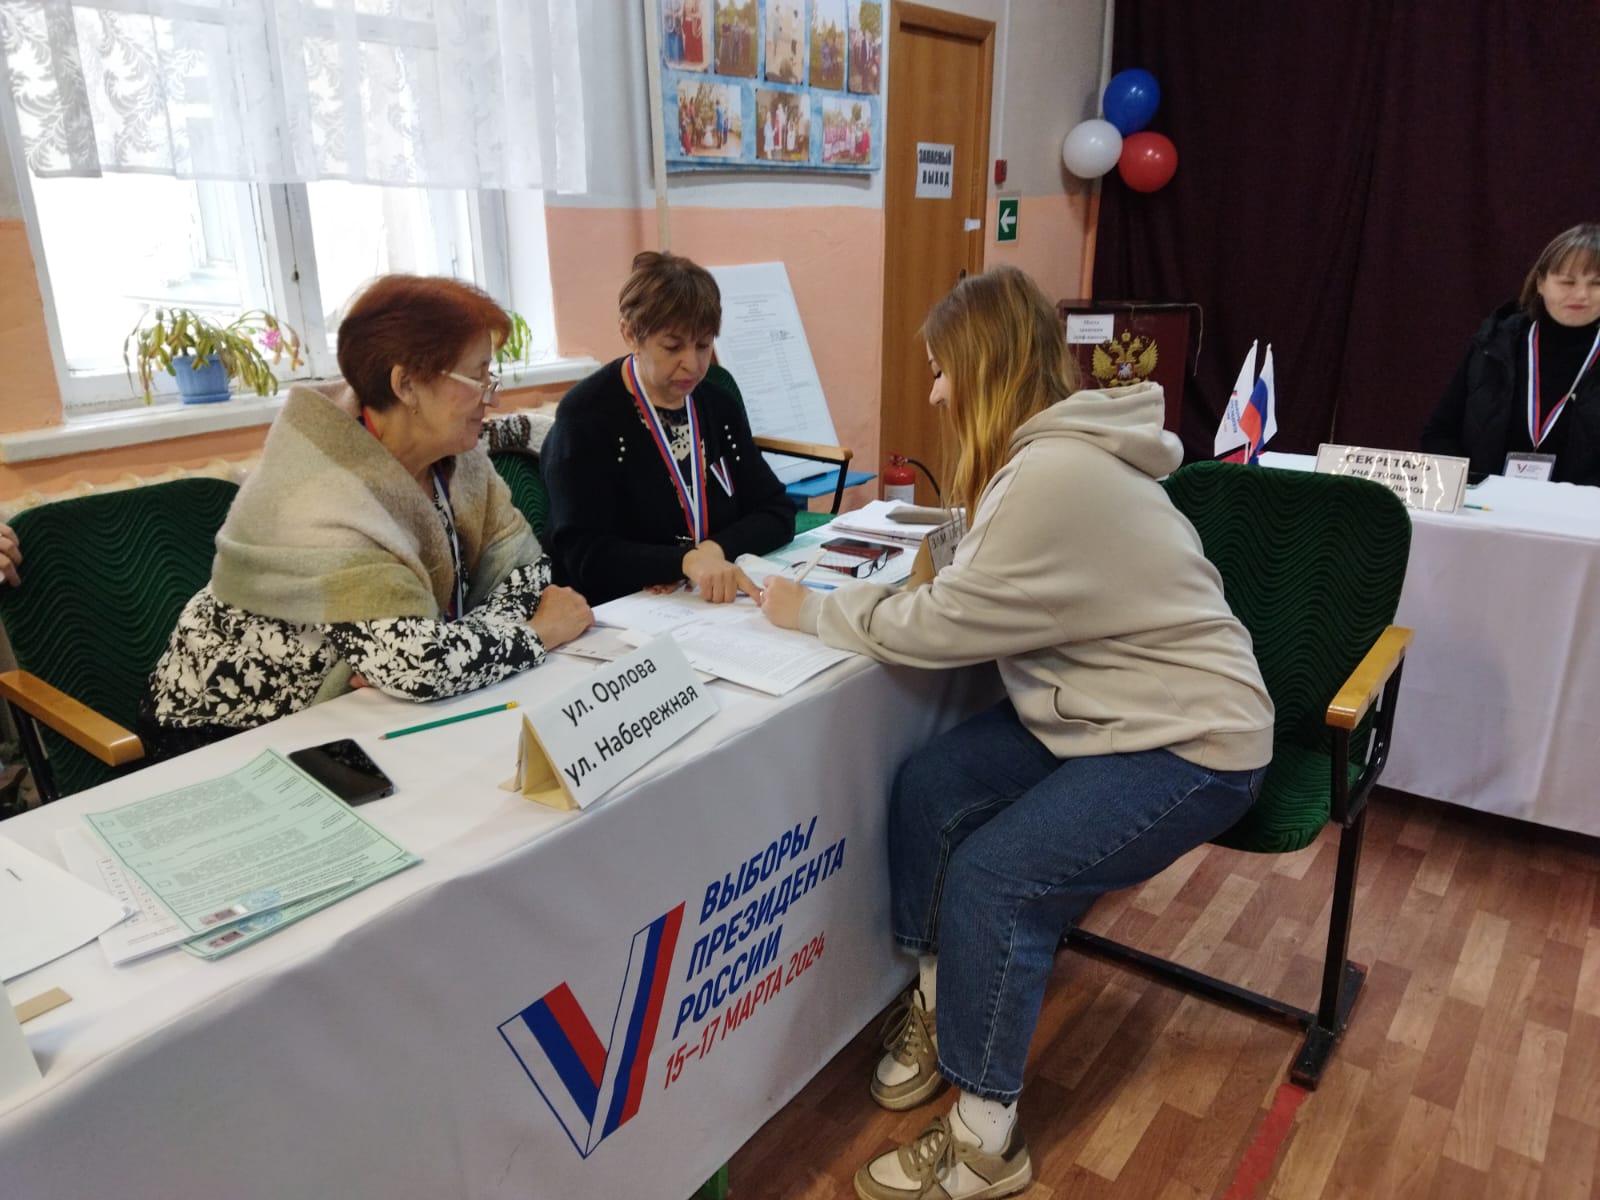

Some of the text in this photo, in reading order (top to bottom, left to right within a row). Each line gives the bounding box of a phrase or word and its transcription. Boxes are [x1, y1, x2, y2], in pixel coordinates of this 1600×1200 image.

[922, 170, 949, 188] ВЫХОД
[561, 657, 657, 727] ул. Орлова
[564, 684, 699, 787] ул. Набережная
[686, 837, 846, 983] ПРЕЗИДЕНТА
[699, 815, 818, 926] ВЫБОРЫ
[672, 924, 783, 1041] РОССИИ
[721, 964, 783, 1041] МАРТА
[784, 930, 825, 987] 2024
